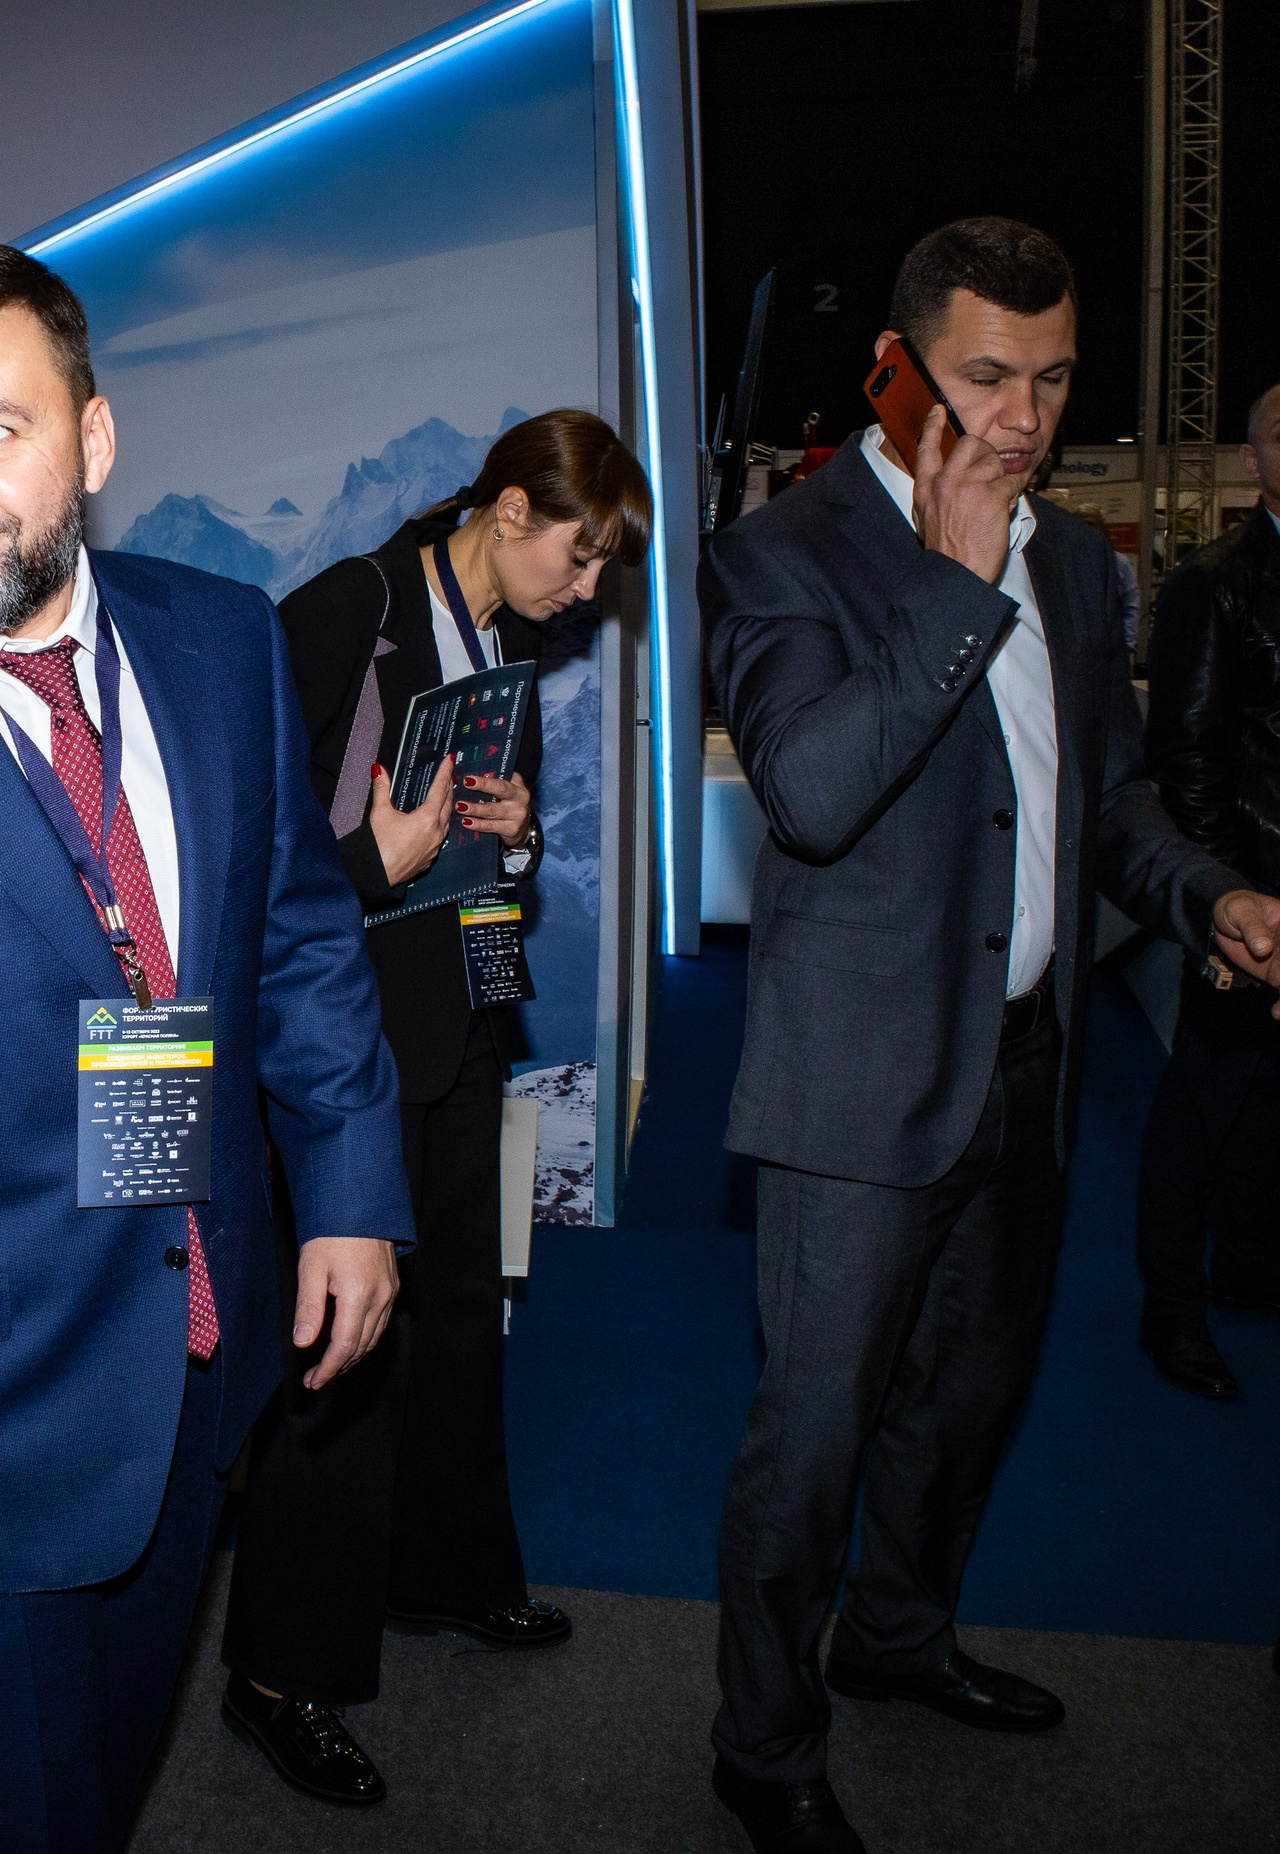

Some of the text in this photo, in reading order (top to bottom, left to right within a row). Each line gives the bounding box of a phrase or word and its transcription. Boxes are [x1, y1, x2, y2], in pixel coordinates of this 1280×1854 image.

[813, 284, 838, 311] 2
[122, 1013, 169, 1022] ТЕРРИТОРИЙ
[90, 1029, 114, 1041] FTT
